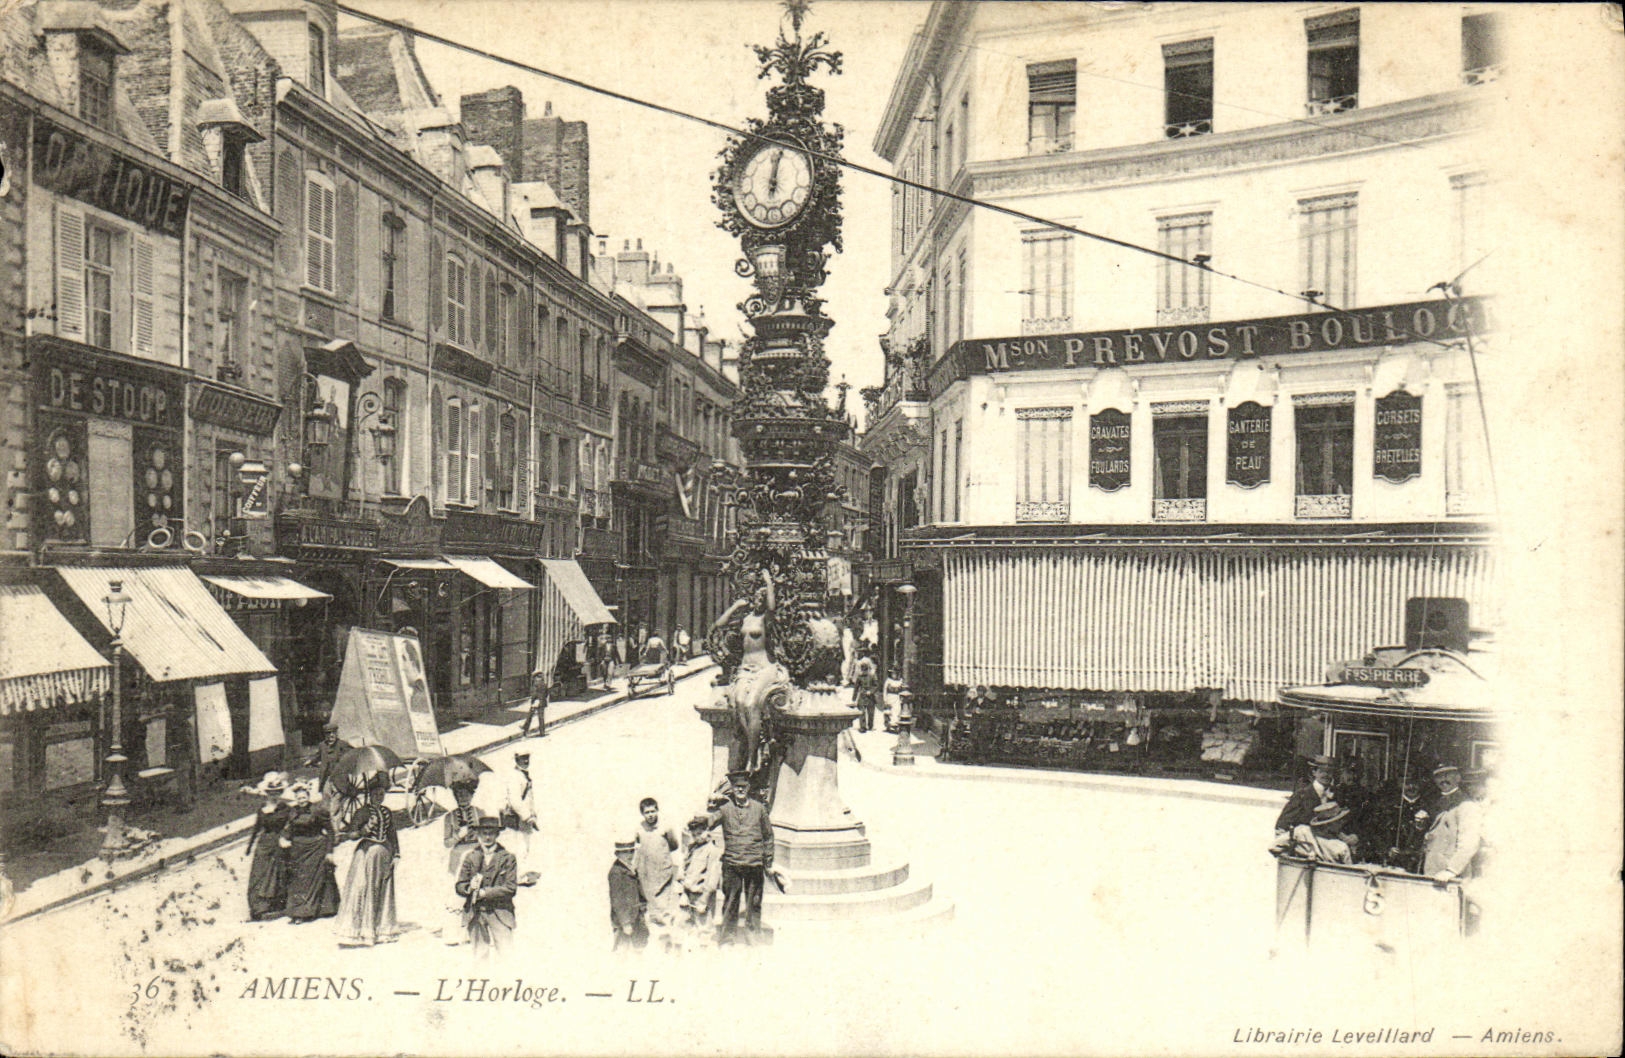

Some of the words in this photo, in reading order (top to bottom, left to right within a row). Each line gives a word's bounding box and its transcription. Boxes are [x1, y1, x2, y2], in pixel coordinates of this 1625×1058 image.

[1063, 326, 1258, 364] PRÉVOST
[51, 368, 82, 410] DE
[1377, 409, 1421, 425] CORSETS
[1091, 425, 1130, 439] CRAVATES
[1229, 418, 1271, 434] GANTERIE
[1241, 440, 1256, 449] DE
[1376, 448, 1420, 463] BRETELLES
[1091, 460, 1129, 474] FOULARDS
[1235, 456, 1263, 471] PEAU
[242, 475, 267, 514] COIFFEUR
[1373, 669, 1422, 682] PIERRE
